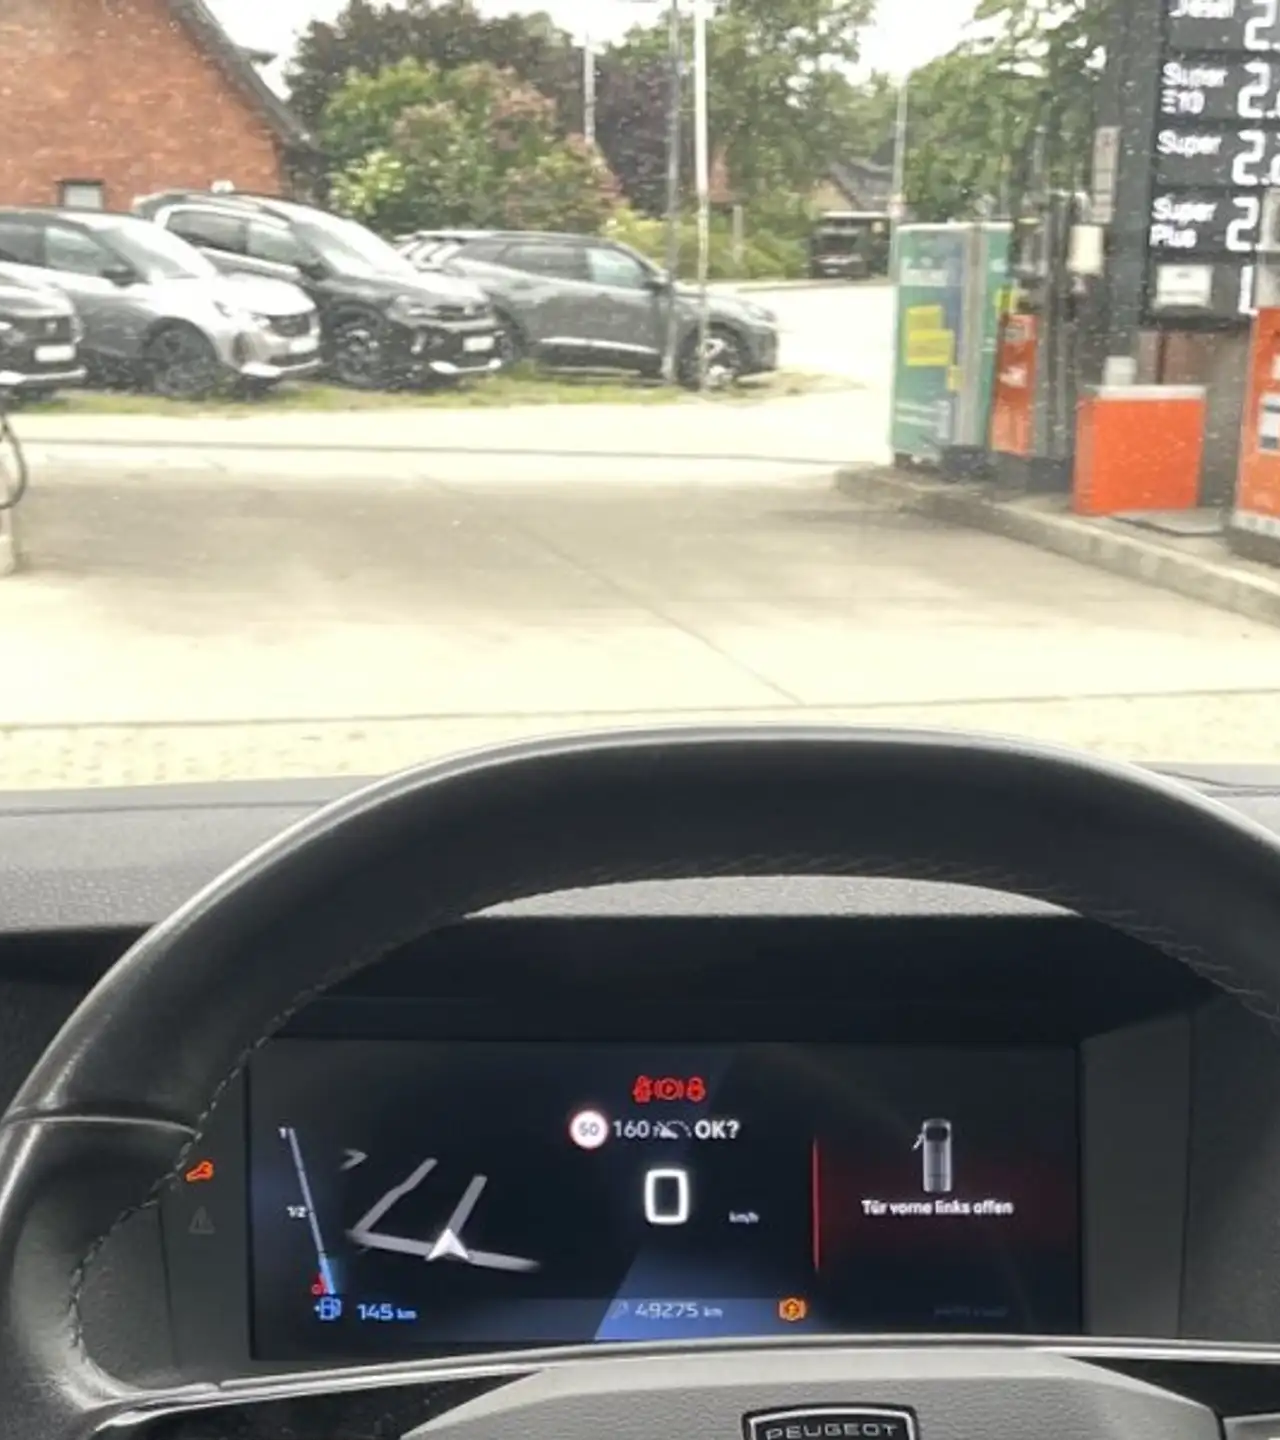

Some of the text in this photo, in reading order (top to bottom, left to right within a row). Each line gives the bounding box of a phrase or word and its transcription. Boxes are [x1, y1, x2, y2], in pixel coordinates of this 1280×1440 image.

[1161, 61, 1228, 88] Super
[1156, 130, 1222, 158] Super
[1151, 196, 1218, 226] Super
[1149, 223, 1198, 248] Plus
[613, 1119, 651, 1139] 160
[694, 1119, 740, 1139] OK?
[644, 1168, 690, 1224] 0
[861, 1199, 888, 1216] Tür
[889, 1202, 932, 1216] vorne
[934, 1200, 970, 1216] links
[356, 1303, 417, 1321] 145 km
[634, 1302, 699, 1319] 49275
[765, 1423, 898, 1440] PEUGEOT
